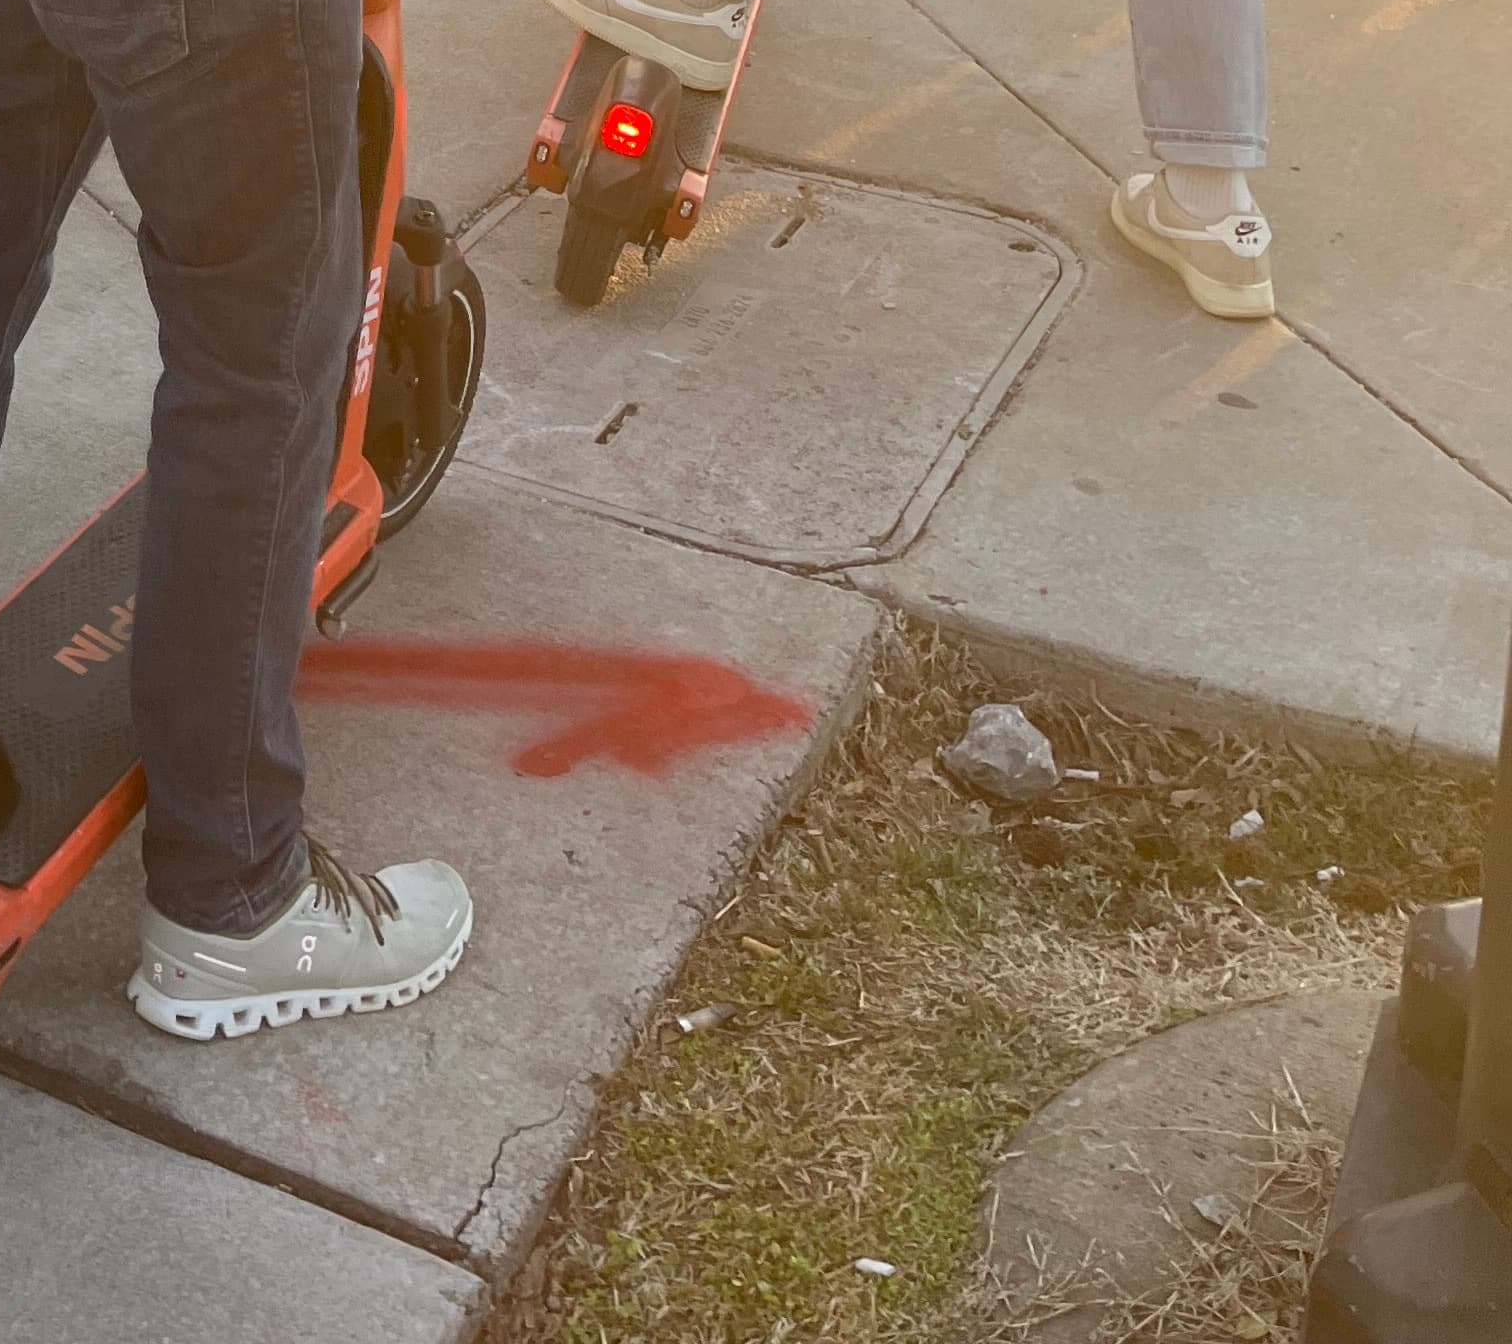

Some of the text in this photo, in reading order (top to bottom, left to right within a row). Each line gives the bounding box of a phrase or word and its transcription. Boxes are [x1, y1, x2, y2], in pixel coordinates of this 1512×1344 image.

[1236, 237, 1258, 245] AIR
[354, 266, 383, 397] SPIN
[54, 593, 136, 676] PIN
